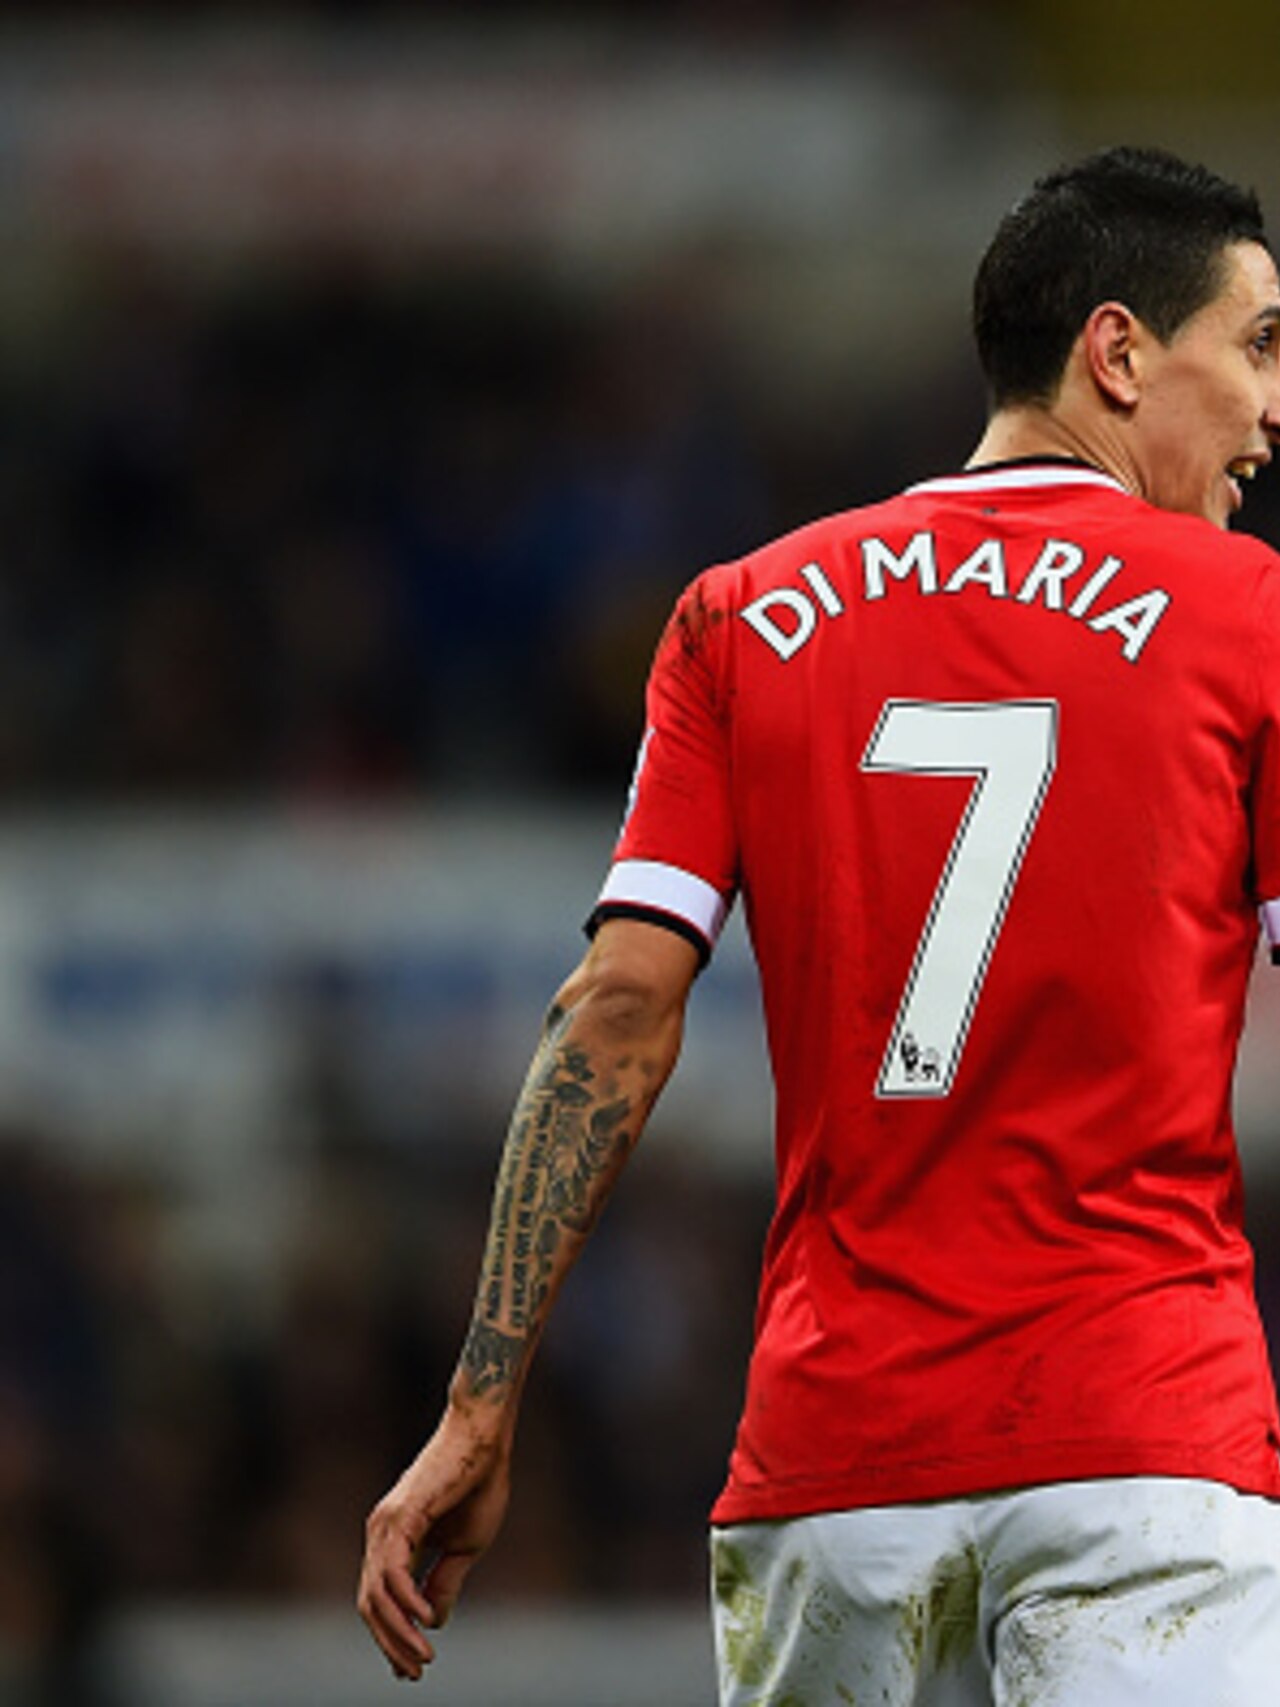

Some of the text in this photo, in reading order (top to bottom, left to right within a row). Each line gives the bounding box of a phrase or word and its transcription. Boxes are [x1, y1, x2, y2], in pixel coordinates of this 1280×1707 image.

[739, 530, 1173, 664] DI MARIA
[859, 698, 1060, 1099] 7
